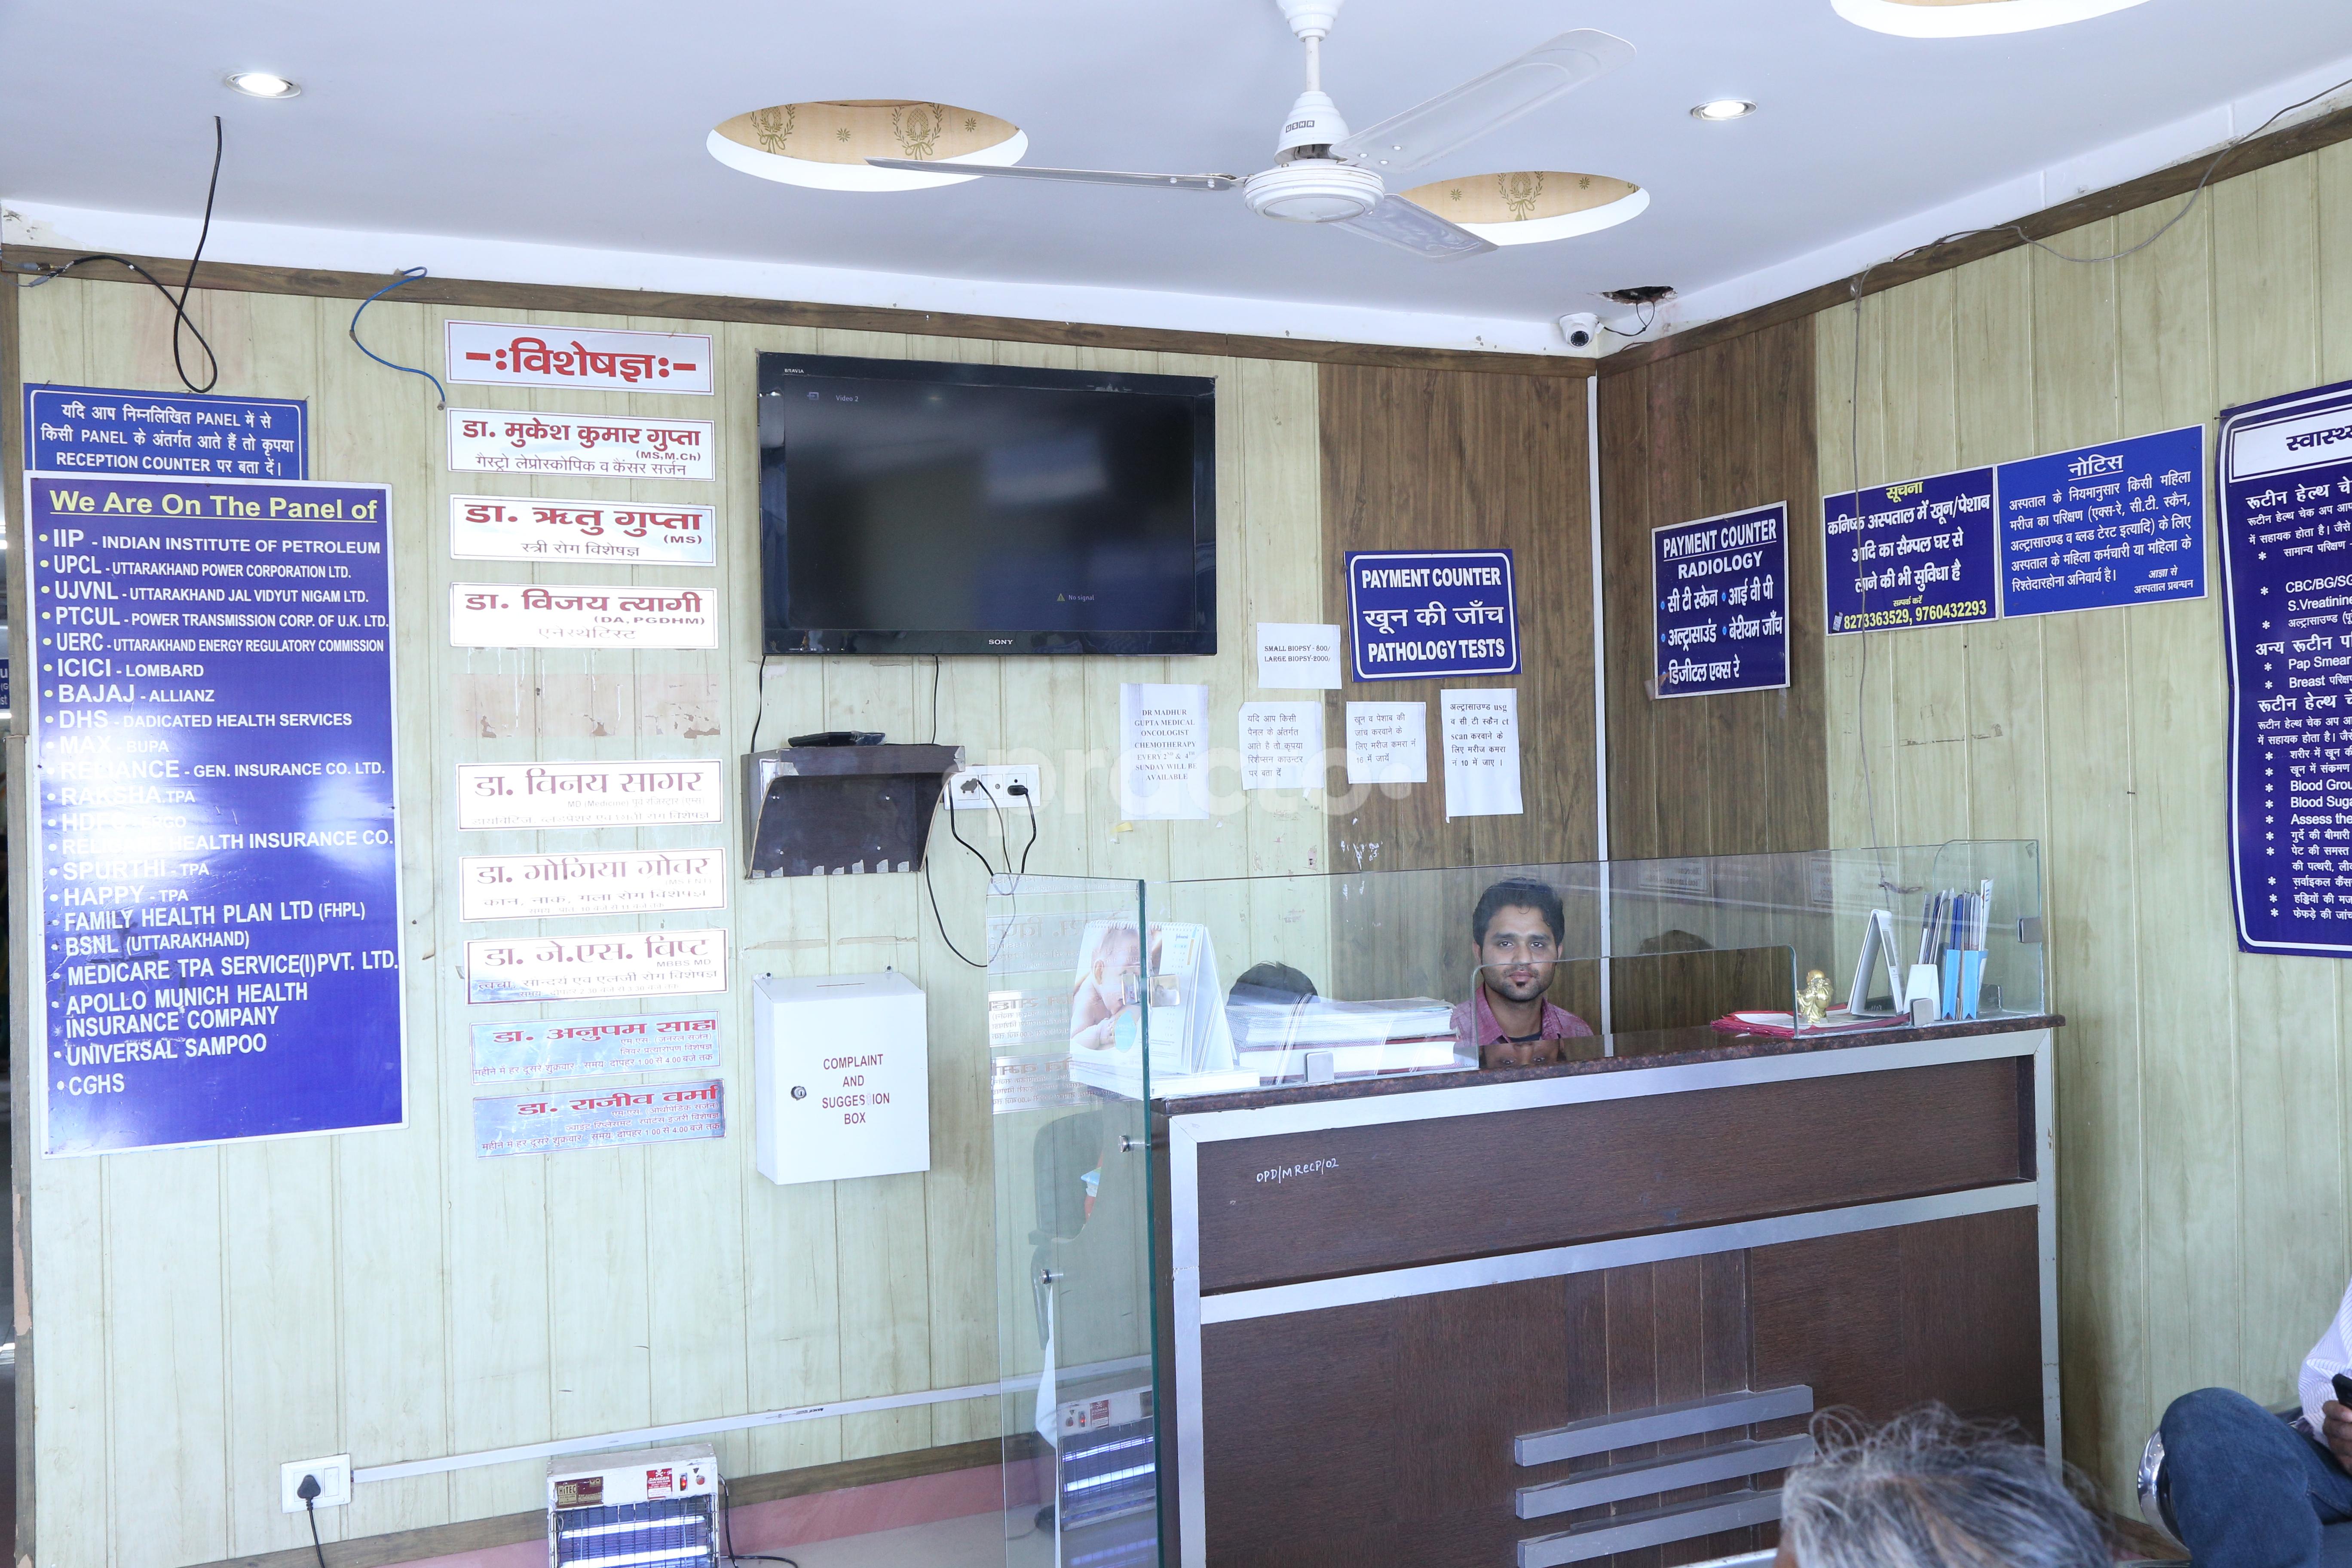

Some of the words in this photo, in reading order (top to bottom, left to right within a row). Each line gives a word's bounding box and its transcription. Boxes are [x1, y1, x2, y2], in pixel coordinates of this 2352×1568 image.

[1286, 120, 1314, 133] USHA
[122, 404, 191, 424] निम्नलिखित
[197, 412, 240, 426] PANEL
[82, 430, 127, 444] PANEL
[57, 452, 138, 468] RECEPTION
[143, 456, 210, 471] COUNTER
[50, 490, 95, 512] We
[103, 493, 152, 513] Are
[162, 494, 200, 514] On
[210, 496, 260, 516] The
[270, 498, 342, 518] Panel
[352, 500, 377, 519] of
[54, 529, 83, 547] IIP
[103, 536, 160, 549] INDIAN
[166, 538, 250, 551] INSTITUTE
[256, 540, 277, 551] OF
[283, 541, 380, 554] PETROLEUM
[664, 535, 701, 544] (MS)
[1664, 530, 1717, 558] PAYMENT
[1721, 519, 1776, 548] COUNTER
[54, 555, 101, 573] UPCL
[112, 562, 198, 576] UTTARAKHAND
[202, 564, 243, 576] POWER
[247, 565, 325, 577] CORPORATION
[329, 566, 351, 578] LTD.
[1678, 551, 1762, 579] RADIOLOGY
[1362, 569, 1430, 588] PAYMENT
[1433, 568, 1501, 586] COUNTER
[1078, 594, 1094, 602] signal
[1916, 600, 1986, 621] 9760432293
[57, 633, 103, 651] UERC
[114, 639, 196, 651] UTTARAKHAND
[199, 640, 243, 652] ENERGY
[246, 640, 315, 652] REGULATORY
[319, 640, 383, 651] COMMISSION
[1368, 640, 1457, 662] PATHOLOGY
[1459, 638, 1504, 658] TESTS
[58, 658, 110, 677] ICICI
[126, 665, 203, 677] LOMBARD
[2289, 657, 2310, 671] Pap
[2314, 656, 2351, 667] Smear
[2290, 675, 2325, 688] Breast
[59, 685, 134, 705] BAJAJ
[149, 690, 214, 702] ALLIANZ
[60, 710, 108, 729] DHS
[124, 714, 211, 728] DADICATED
[217, 714, 275, 726] HEALTH
[280, 714, 352, 726] SERVICES
[2291, 780, 2322, 791] Blood
[2291, 814, 2332, 824] Assess
[2335, 813, 2352, 824] the
[64, 910, 132, 931] FAMILY
[141, 906, 214, 927] HEALTH
[224, 903, 272, 923] PLAN
[281, 901, 312, 920] LTD
[319, 902, 365, 922] (FHPL)
[66, 991, 146, 1015] APOLLO
[156, 986, 228, 1009] MUNICH
[238, 982, 307, 1003] HEALTH
[67, 1012, 179, 1040] INSURANCE
[188, 1006, 279, 1029] COMPANY
[65, 1042, 178, 1066] UNIVERSAL
[185, 1033, 266, 1057] SAMPOO
[824, 1054, 883, 1069] COMPLAINT
[69, 1073, 124, 1096] CGHS
[843, 1075, 864, 1087] AND
[845, 1112, 866, 1124] BOX
